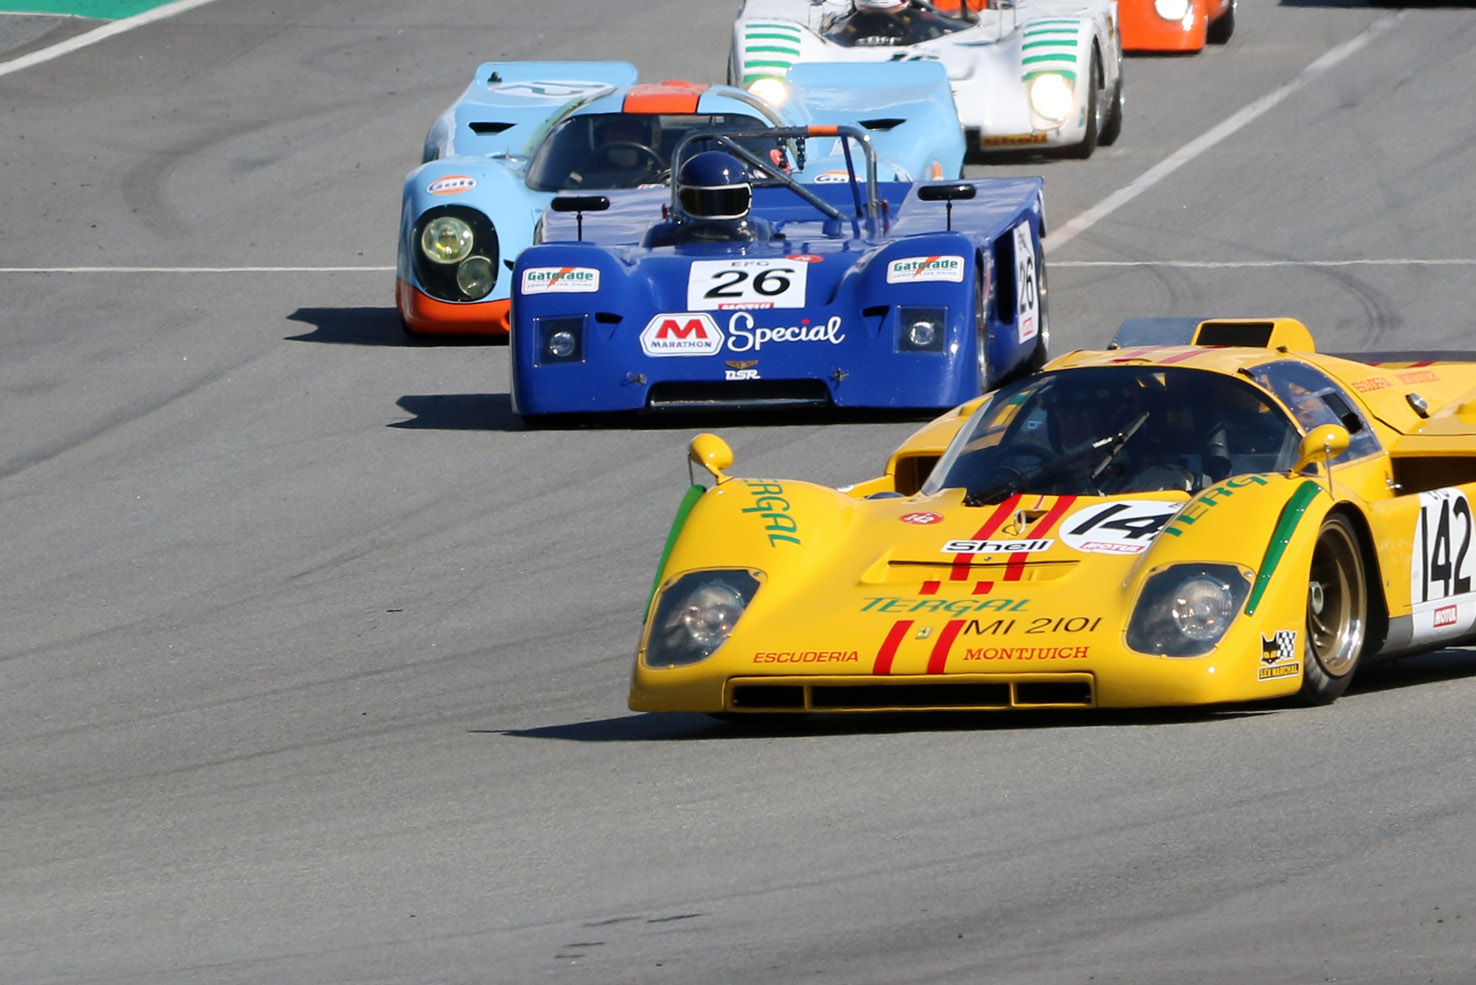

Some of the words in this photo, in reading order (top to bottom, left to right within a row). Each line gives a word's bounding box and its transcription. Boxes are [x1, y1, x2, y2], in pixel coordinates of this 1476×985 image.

[427, 178, 475, 192] Gulf
[893, 259, 959, 272] Gatorade
[527, 271, 594, 281] Gatorade
[703, 268, 797, 300] 26
[727, 312, 846, 352] Special
[650, 341, 712, 349] MARATHON
[741, 478, 802, 548] RGAL
[1067, 503, 1177, 542] 14
[946, 540, 1049, 552] Shell
[1420, 496, 1472, 603] 142
[859, 596, 1031, 617] TERGAL
[1434, 606, 1458, 626] MOTUL
[1025, 617, 1103, 635] 2101
[752, 651, 860, 664] ESCUDERIA
[962, 646, 1090, 661] MONTJUICH
